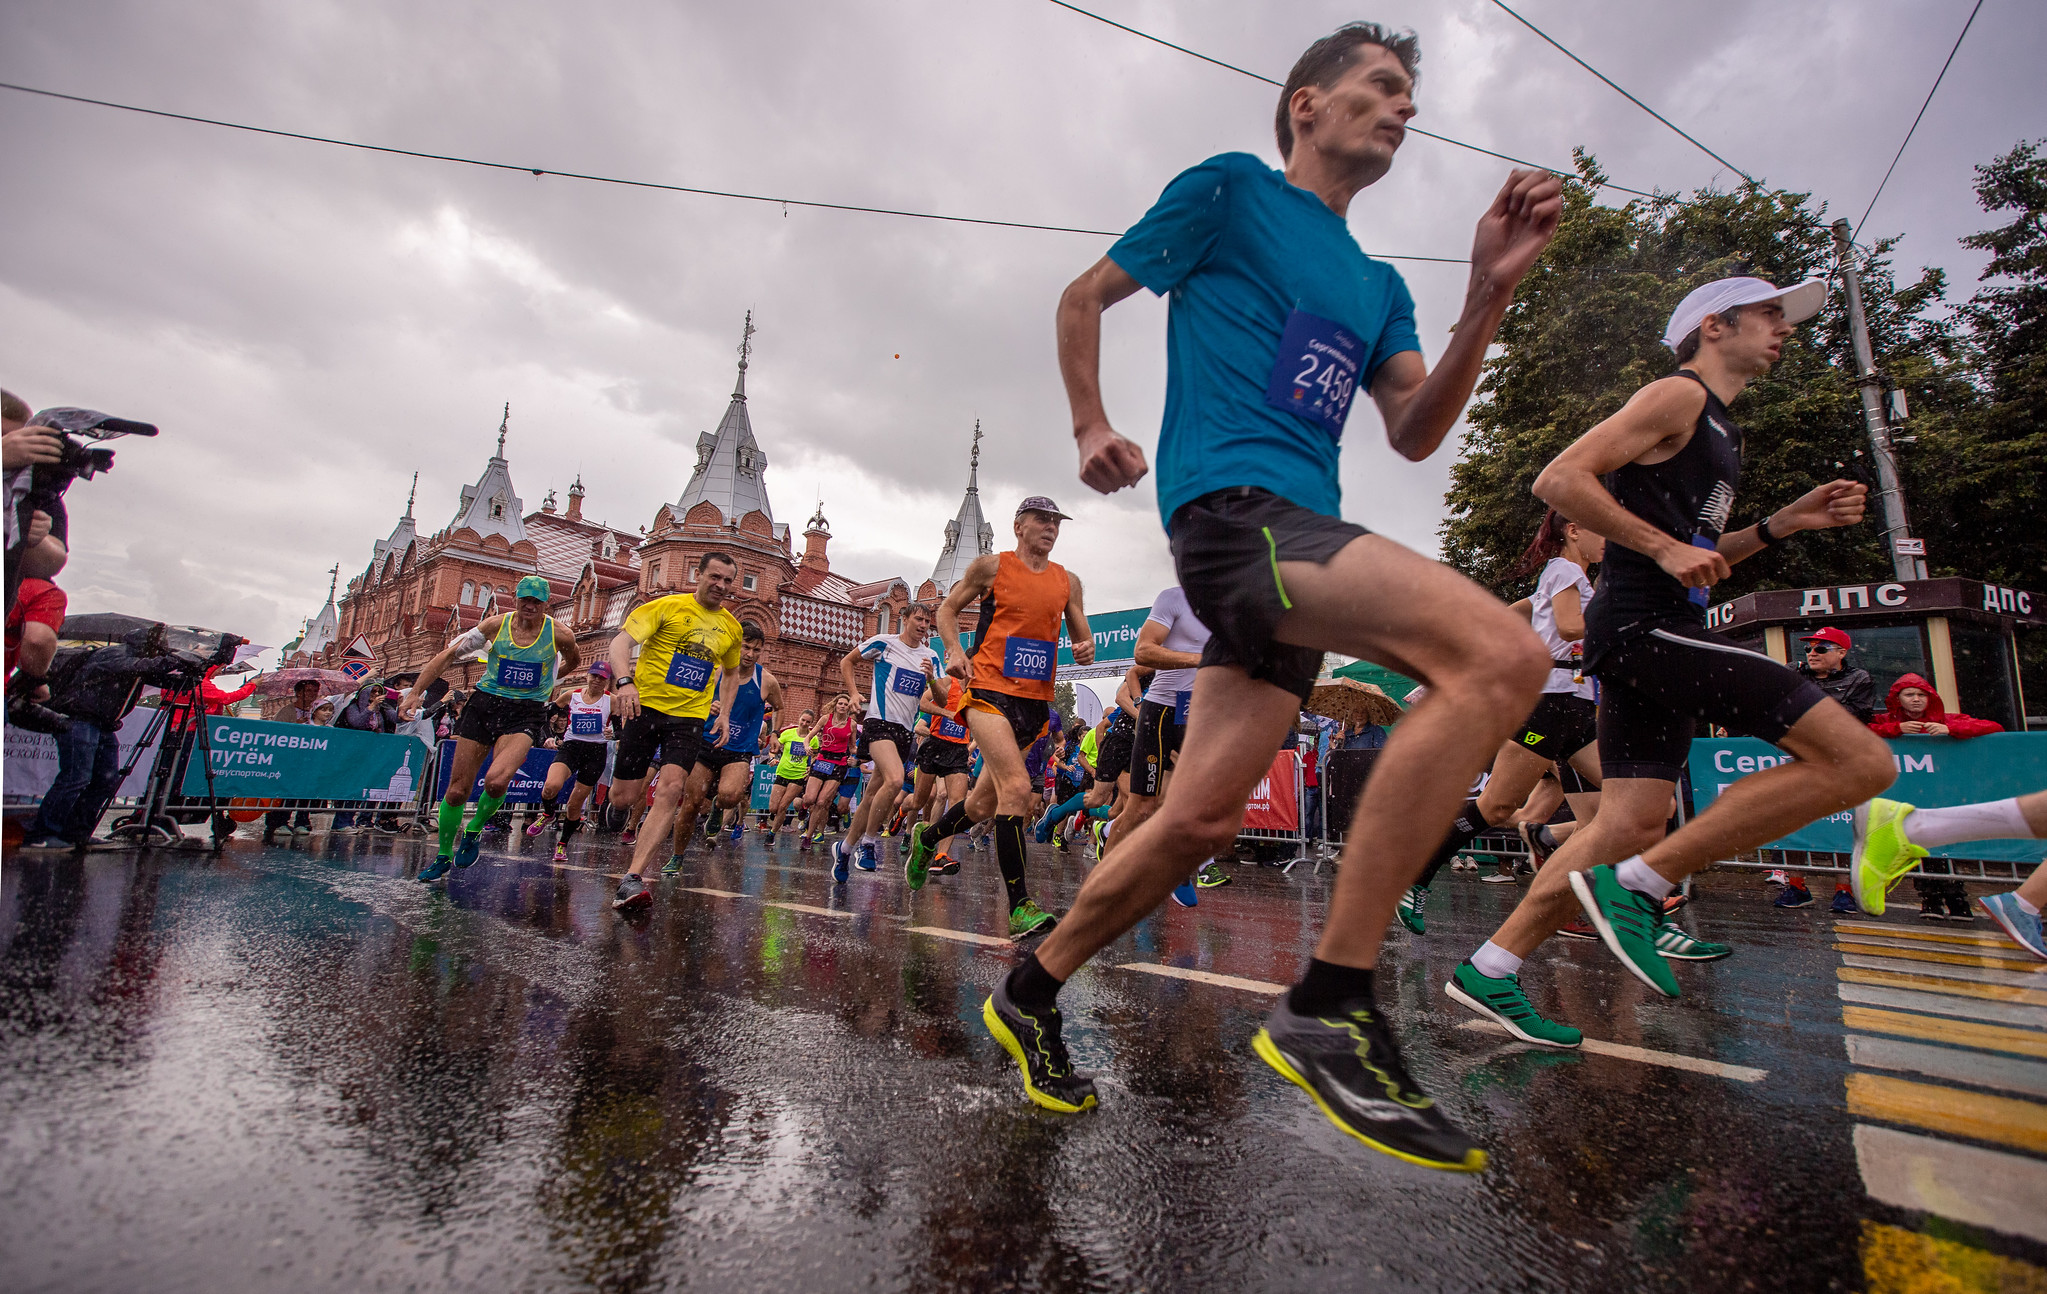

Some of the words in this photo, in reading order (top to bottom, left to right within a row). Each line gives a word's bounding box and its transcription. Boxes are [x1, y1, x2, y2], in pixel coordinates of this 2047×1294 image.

[1293, 353, 1353, 409] 2459
[1800, 584, 1908, 616] ДПС
[1983, 584, 2032, 615] ДПС
[1704, 602, 1735, 630] ПС
[1093, 624, 1142, 648] путём
[1013, 652, 1047, 669] 2008
[504, 669, 534, 681] 2198
[675, 666, 705, 682] 2204
[899, 677, 921, 691] 2272
[576, 721, 596, 729] 2201
[729, 727, 741, 737] 52
[214, 725, 328, 750] Сергиевым
[210, 748, 273, 767] путём
